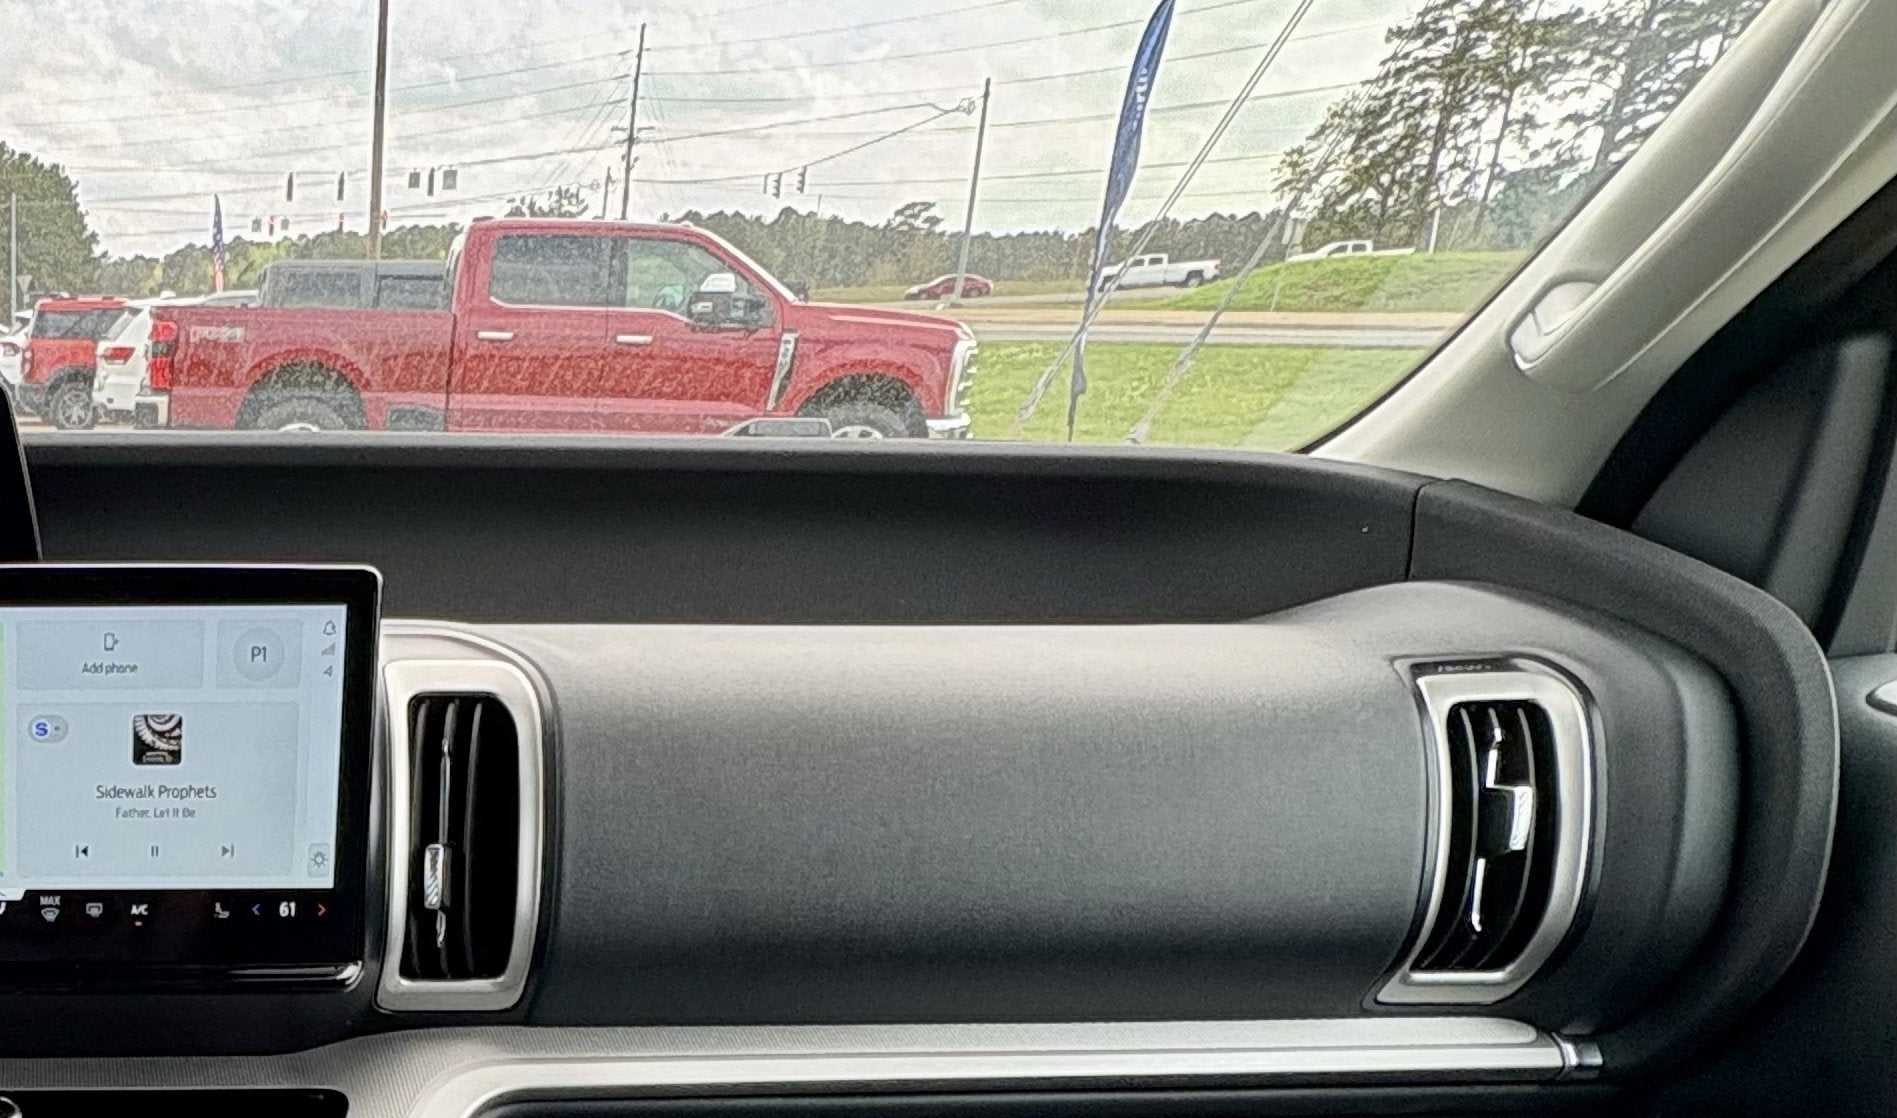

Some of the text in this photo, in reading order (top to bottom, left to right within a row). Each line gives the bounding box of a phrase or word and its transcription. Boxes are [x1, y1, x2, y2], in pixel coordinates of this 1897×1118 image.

[250, 646, 268, 662] P1
[81, 661, 138, 678] Add phone
[96, 784, 217, 802] Sidewalk Prophets
[39, 895, 61, 906] MAX
[130, 903, 149, 916] A/C
[279, 901, 297, 918] 61
